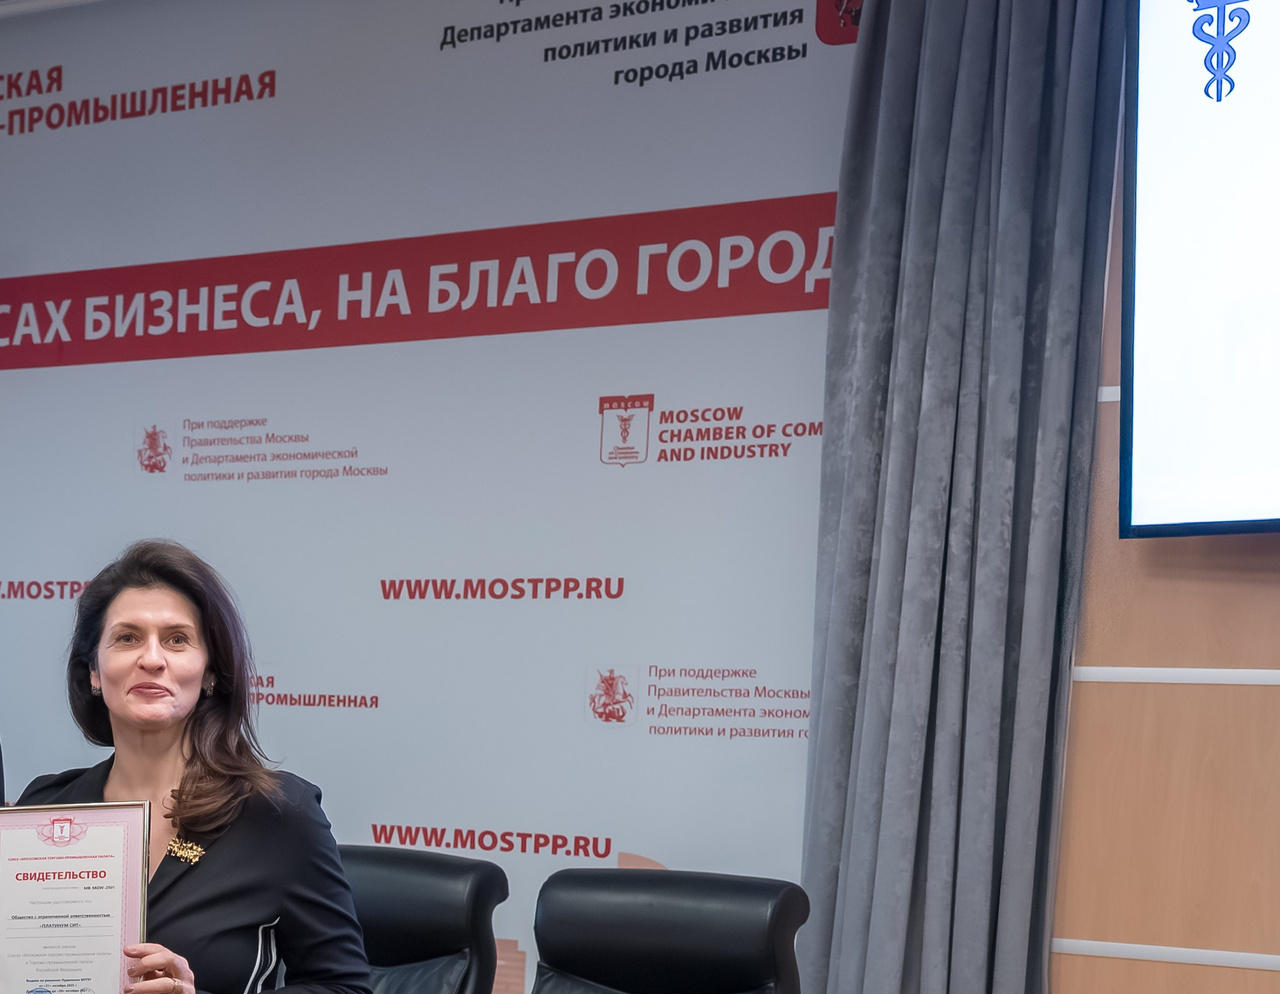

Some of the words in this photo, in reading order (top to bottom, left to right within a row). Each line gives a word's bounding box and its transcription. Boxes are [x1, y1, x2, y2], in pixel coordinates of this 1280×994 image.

[440, 6, 603, 50] Департамента
[609, 0, 715, 19] эконо
[544, 31, 657, 62] политики
[663, 28, 678, 44] и
[684, 8, 804, 46] развития
[614, 59, 699, 86] города
[705, 43, 808, 72] Москвы
[84, 278, 322, 341] БИЗНЕСА,
[337, 268, 411, 320] НА
[427, 248, 619, 313] БЛАГО
[183, 419, 204, 431] При
[207, 417, 268, 430] поддержке
[659, 406, 743, 425] MOSCOW
[183, 434, 262, 448] Правительства
[265, 432, 309, 444] Москвы
[658, 425, 747, 443] CHAMBER
[752, 423, 776, 439] OF
[781, 421, 823, 438] COM
[182, 456, 189, 464] и
[190, 452, 267, 466] Департамента
[270, 447, 358, 462] экономической
[657, 448, 695, 462] AND
[700, 443, 792, 460] INDUSTRY
[184, 472, 235, 482] политики
[237, 471, 244, 480] и
[247, 469, 297, 483] развития
[300, 467, 339, 480] города
[342, 465, 388, 477] Москвы
[380, 577, 625, 600] WWW.MOSTPP.RU
[648, 665, 676, 680] При
[679, 668, 757, 681] поддержке
[647, 685, 750, 699] Правительства
[754, 686, 810, 699] Москвы
[646, 707, 655, 716] и
[658, 704, 756, 719] Департамента
[649, 725, 713, 736] политики
[717, 726, 726, 736] и
[730, 727, 794, 739] развития
[371, 823, 612, 859] WWW.MOSTPP.RU
[15, 870, 107, 882] СВИДЕТЕЛЬСТВО
